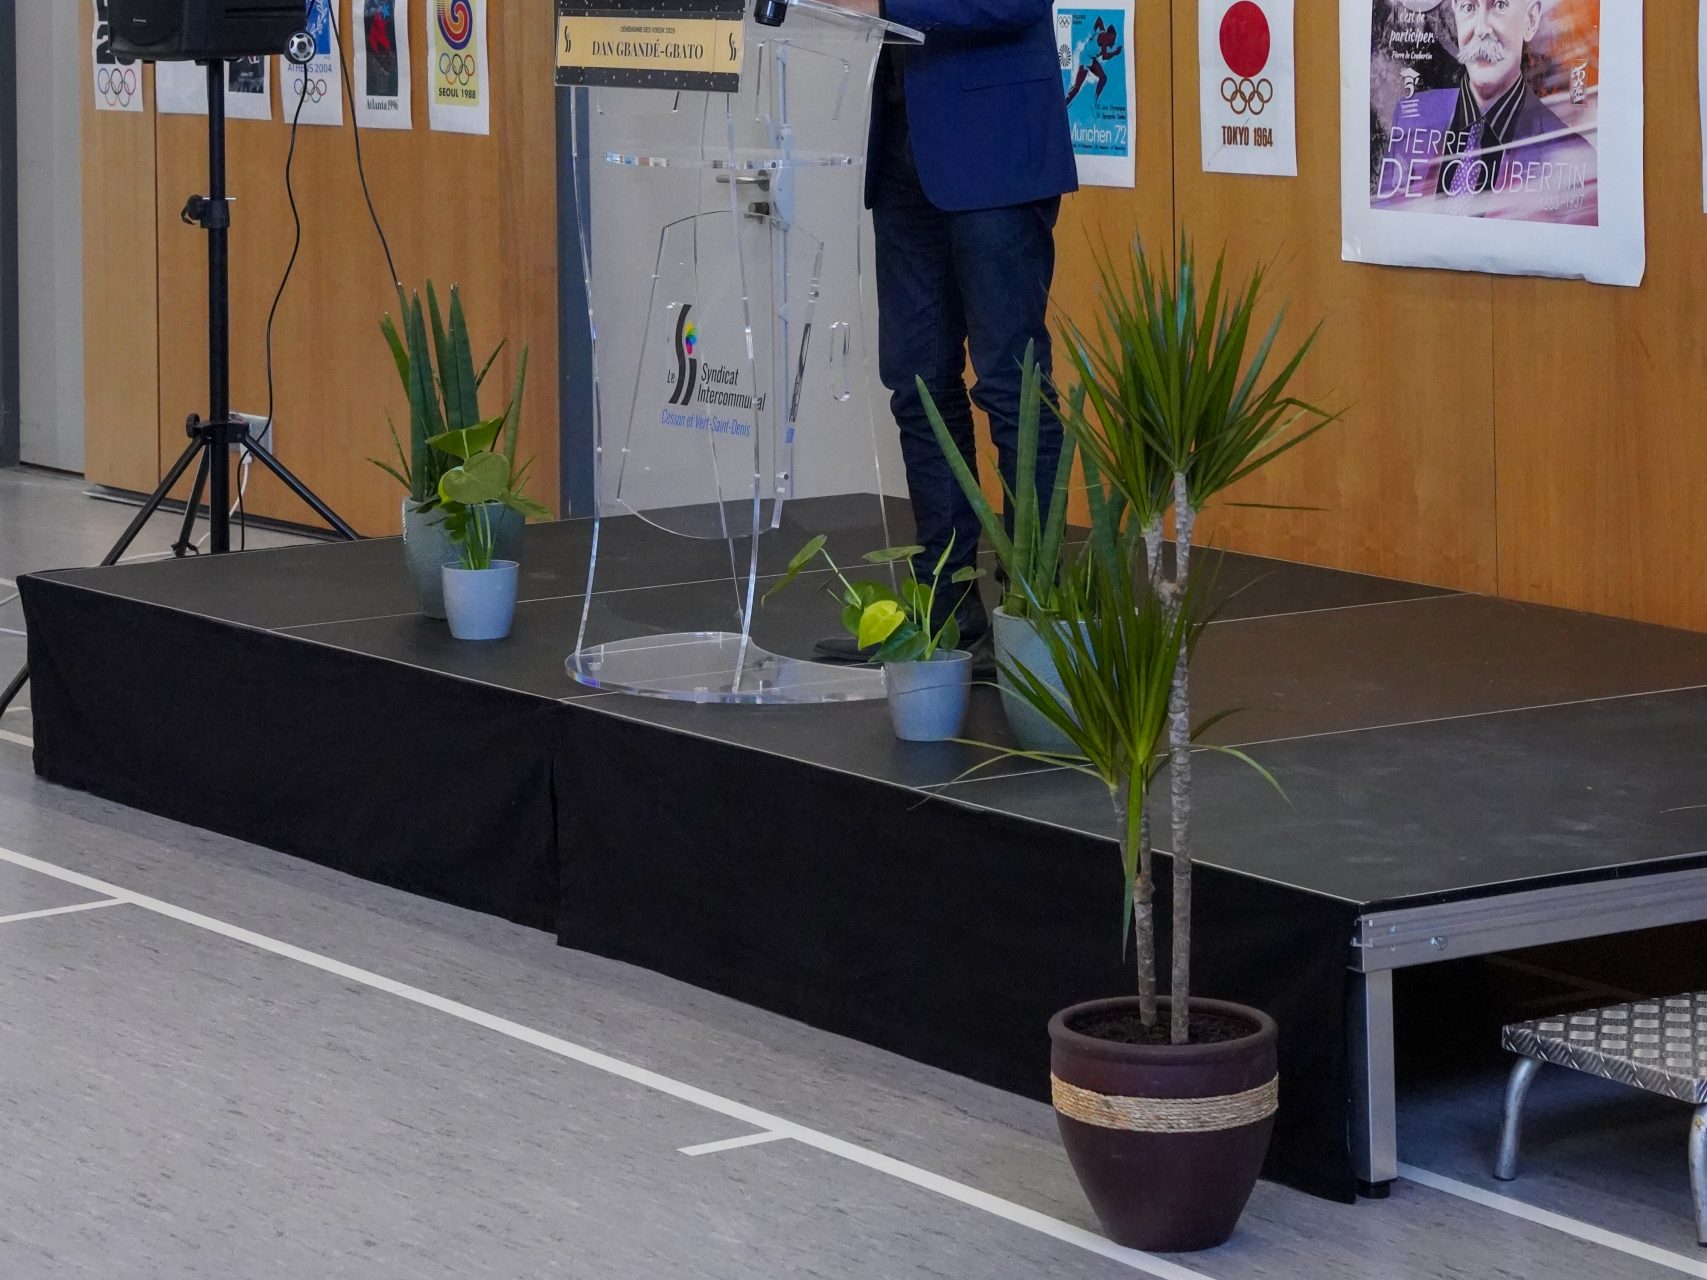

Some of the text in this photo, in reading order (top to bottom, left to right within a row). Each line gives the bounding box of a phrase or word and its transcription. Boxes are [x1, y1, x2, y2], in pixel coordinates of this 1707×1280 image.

[592, 38, 704, 60] DAN GBANDÉ-GBATO
[1388, 27, 1435, 49] participer.
[288, 63, 332, 73] ATHES 2004
[438, 87, 476, 99] SEOUL 1988
[367, 98, 399, 111] Atlanta 1996
[1114, 124, 1127, 144] 72
[1221, 125, 1273, 147] TOKYO 1964
[1387, 126, 1470, 155] PIERRE
[1376, 158, 1586, 199] DE COUBERTIN
[667, 369, 675, 384] Le
[701, 362, 739, 386] Syndicat
[697, 383, 766, 411] Intercommual
[661, 409, 685, 427] Cesson
